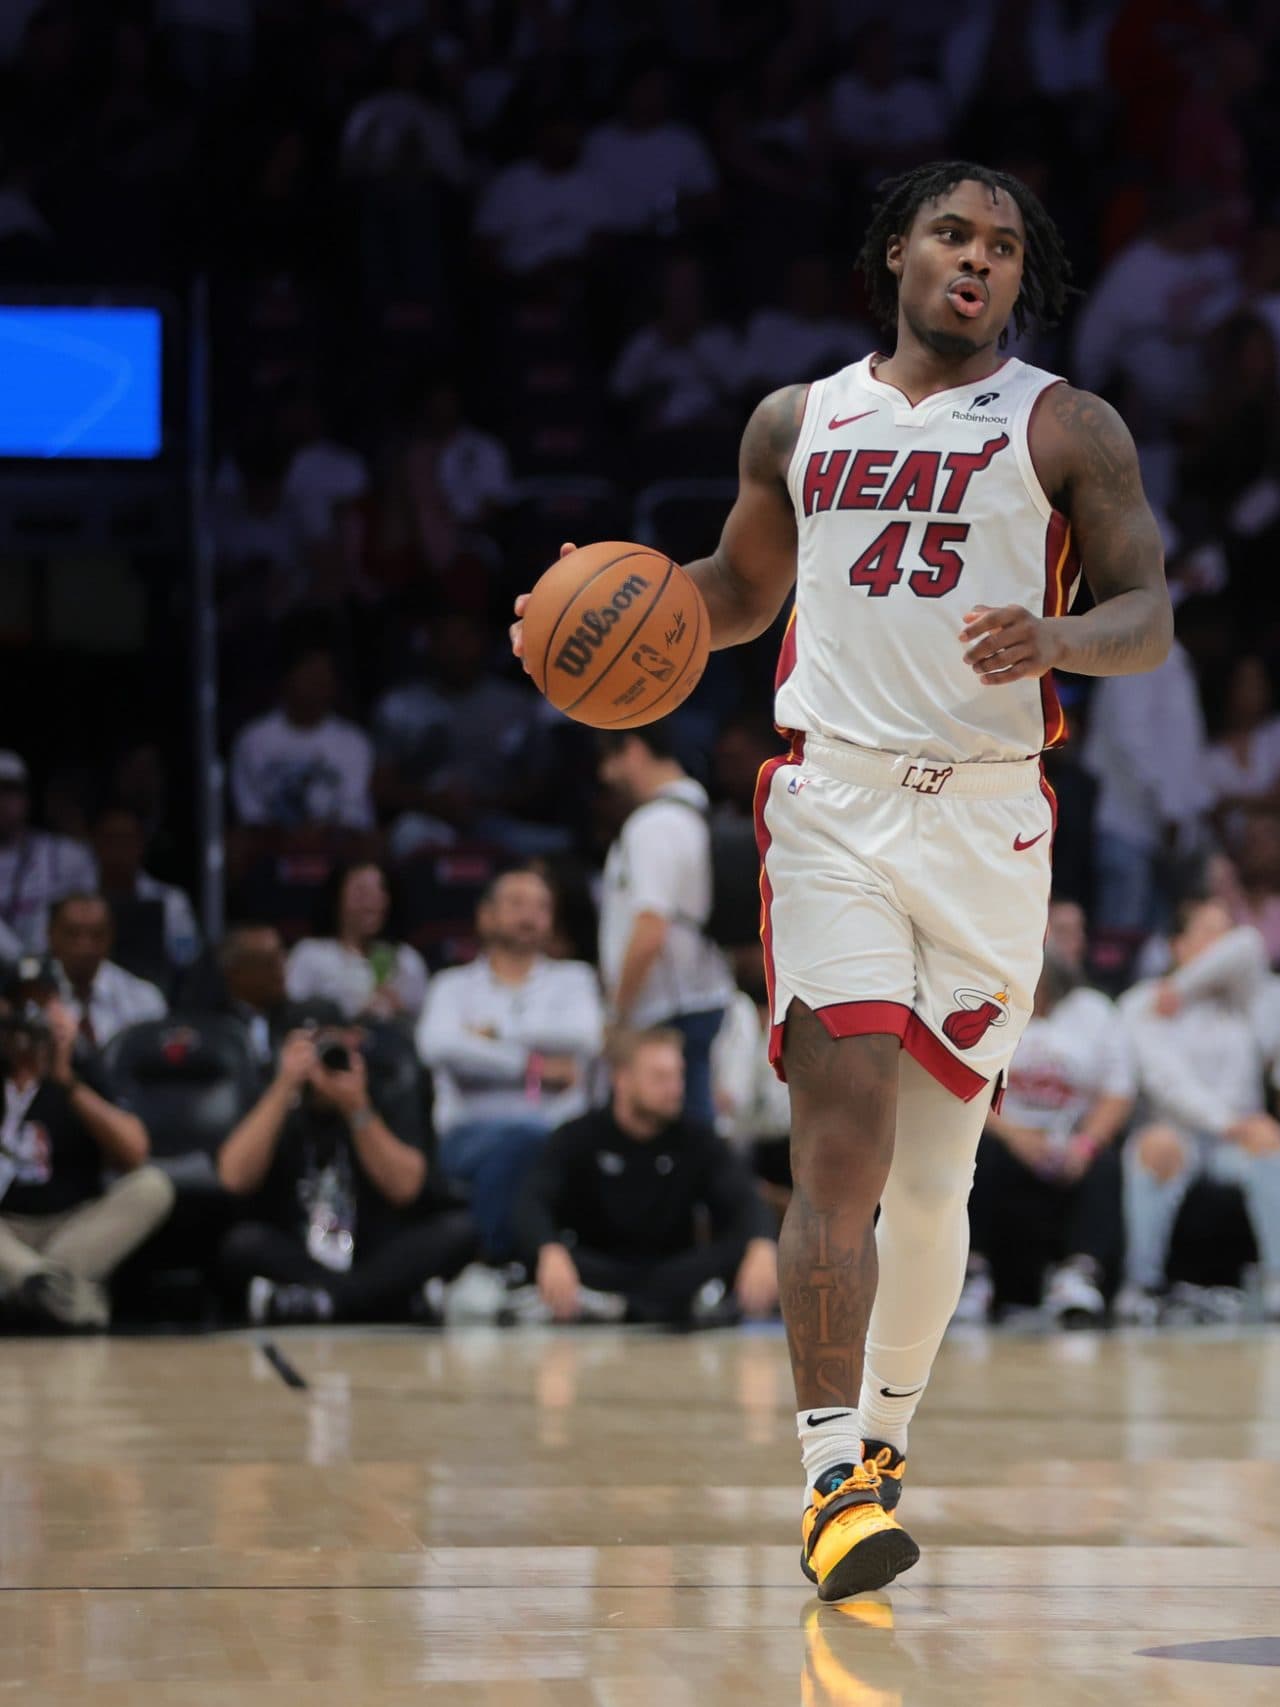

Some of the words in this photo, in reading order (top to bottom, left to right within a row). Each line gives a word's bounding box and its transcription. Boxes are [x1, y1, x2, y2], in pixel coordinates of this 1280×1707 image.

[951, 410, 1008, 425] Robinhood
[803, 431, 1010, 517] HEAT
[849, 521, 970, 598] 45
[554, 574, 650, 678] Wilson
